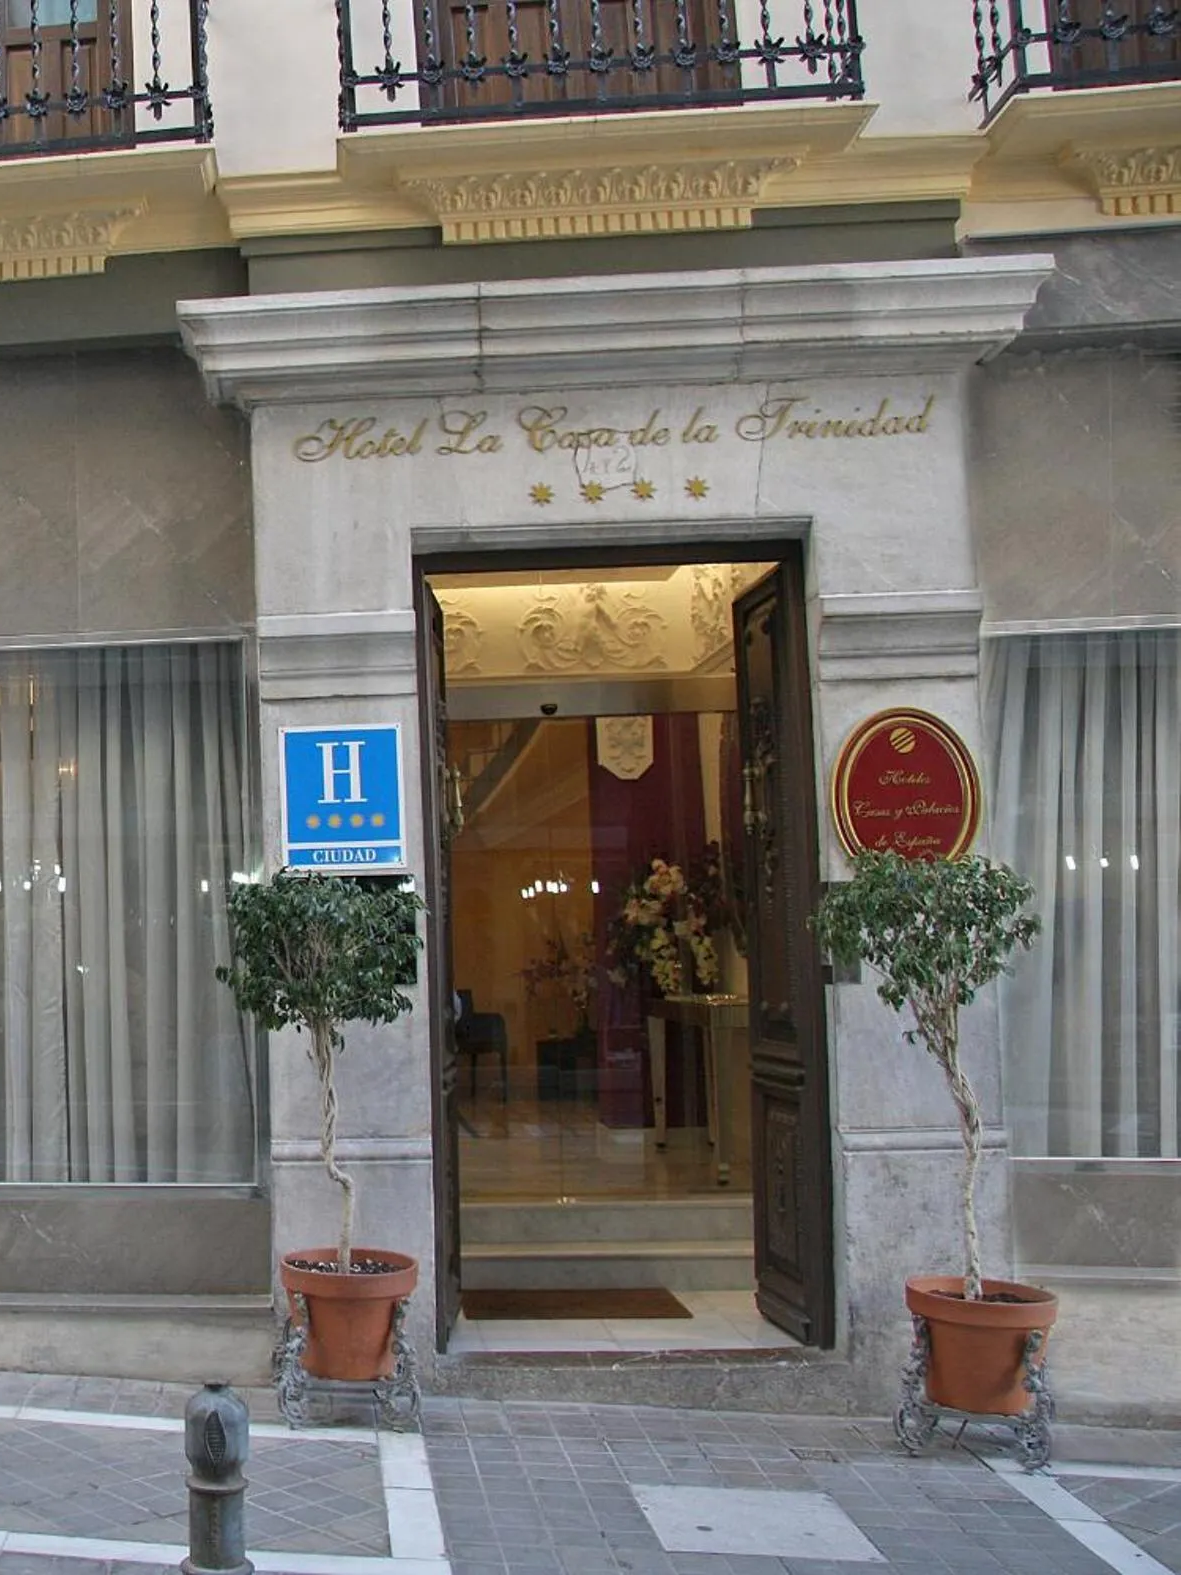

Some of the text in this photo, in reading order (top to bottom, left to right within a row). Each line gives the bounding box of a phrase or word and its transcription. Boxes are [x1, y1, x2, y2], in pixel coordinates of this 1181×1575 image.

[292, 392, 935, 463] Hotel La Casa de la Trinidad
[315, 740, 368, 804] H
[878, 769, 931, 786] Hoteles
[894, 807, 904, 820] y
[875, 834, 888, 847] de
[312, 848, 377, 863] CIUDAD
